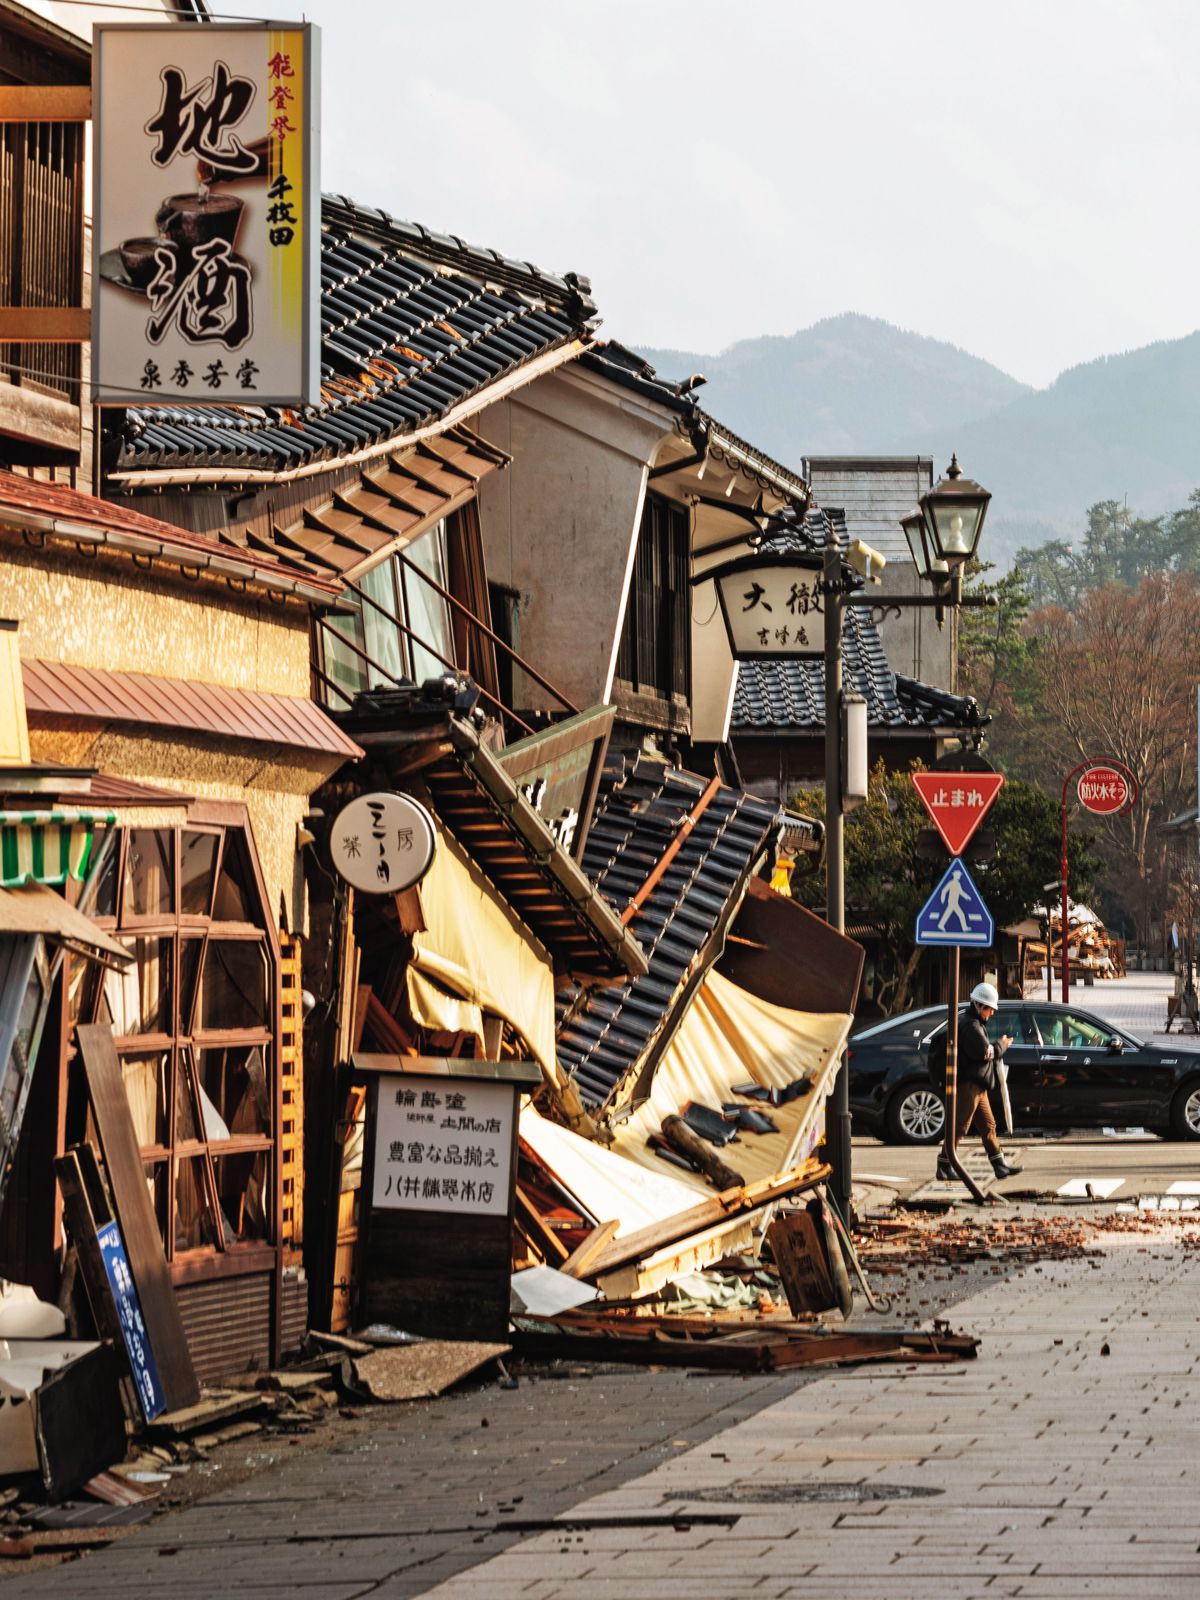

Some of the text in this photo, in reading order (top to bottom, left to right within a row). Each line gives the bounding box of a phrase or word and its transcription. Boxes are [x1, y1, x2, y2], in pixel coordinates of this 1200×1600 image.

[265, 51, 298, 249] 能登誉 千枚田
[145, 60, 259, 352] 地酒
[931, 787, 985, 808] 止まれ
[1081, 781, 1126, 801] 防火水そう
[395, 1087, 467, 1112] 輪島塗
[440, 1114, 502, 1134] 土間の店
[387, 1140, 499, 1169] 豊富な品揃え
